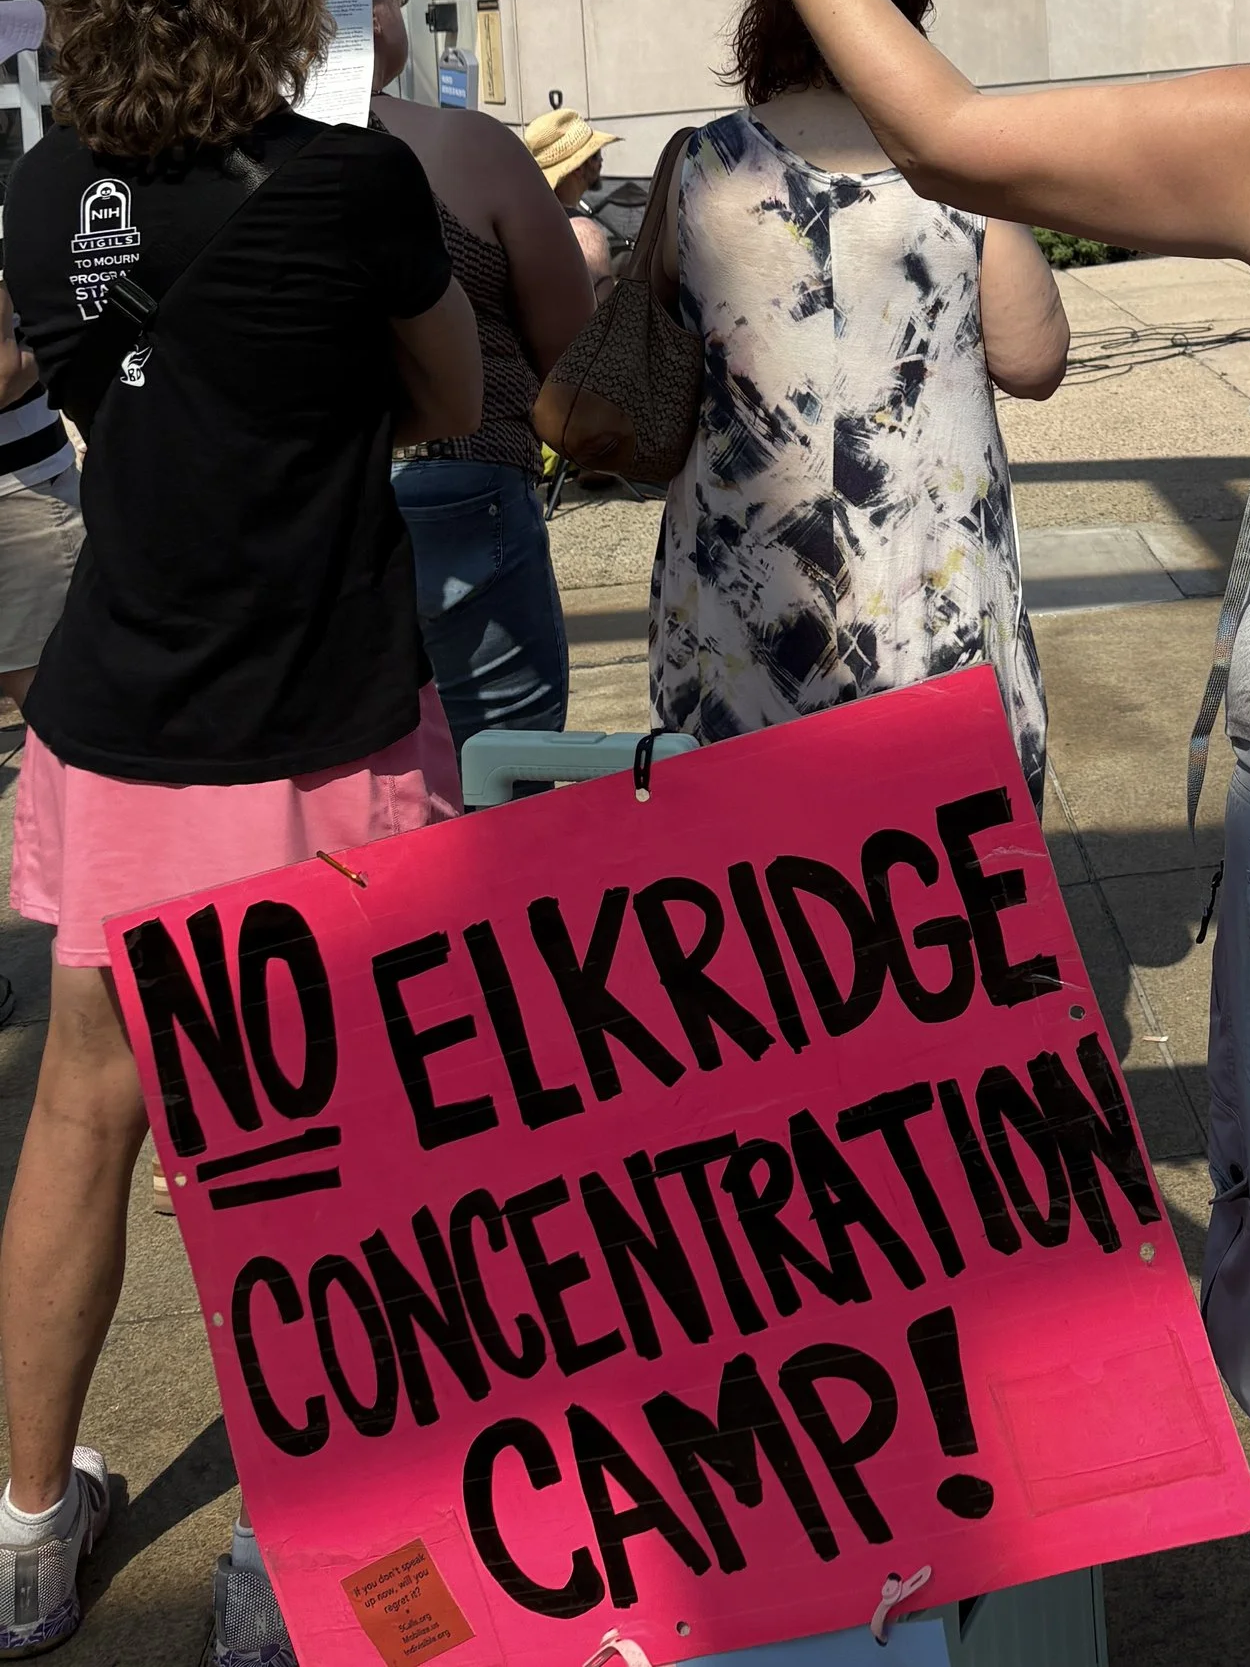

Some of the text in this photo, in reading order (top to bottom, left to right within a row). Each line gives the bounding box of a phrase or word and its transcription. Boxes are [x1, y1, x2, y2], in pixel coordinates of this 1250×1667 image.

[91, 207, 120, 221] NIH
[79, 236, 133, 250] VIGILS
[75, 253, 140, 269] TO MOURN
[69, 270, 131, 285] PROGRA
[75, 284, 109, 301] STA
[124, 787, 1063, 1158] NO ELKRIDGE
[231, 1033, 1160, 1457] CONCENTRATION
[462, 1306, 994, 1619] CAMP!
[353, 1553, 425, 1597] If you don't speak
[364, 1568, 429, 1609] up now, will you
[384, 1586, 422, 1613] regret it?
